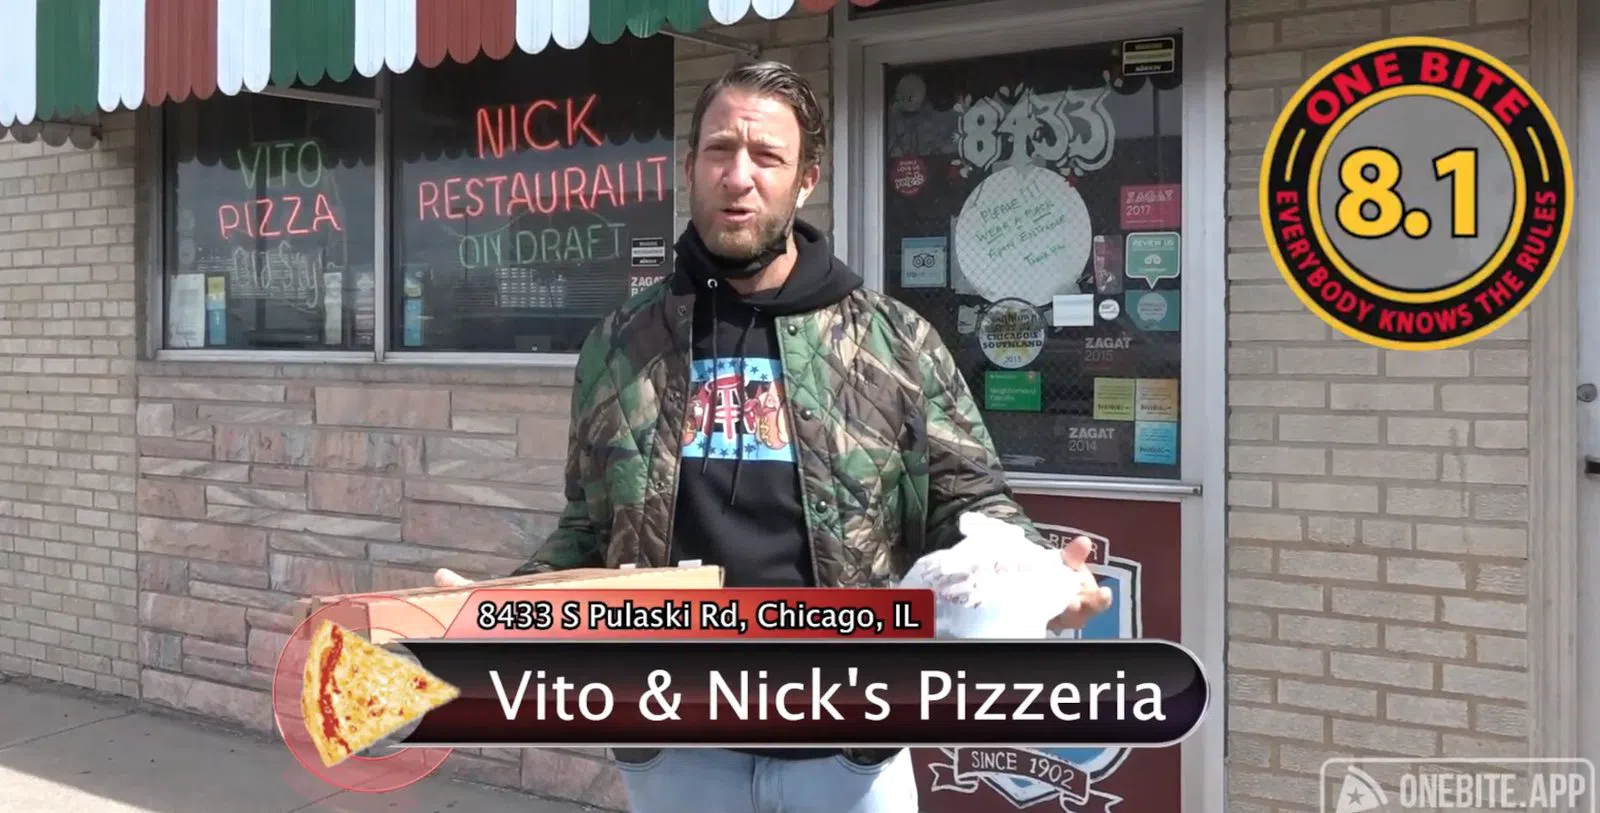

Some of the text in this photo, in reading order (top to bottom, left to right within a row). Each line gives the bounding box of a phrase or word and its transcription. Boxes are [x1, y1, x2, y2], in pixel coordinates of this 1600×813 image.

[476, 95, 604, 159] NICK
[958, 88, 1116, 171] 8433
[236, 140, 323, 190] VITO
[1126, 190, 1174, 204] ZAGAT
[217, 194, 342, 240] PIZZA
[1126, 205, 1151, 217] 2017
[459, 223, 625, 269] ON DRAFT
[631, 276, 664, 287] ZAGA
[982, 340, 1042, 350] SOUTHLAND
[1084, 337, 1132, 349] ZAGAT
[1085, 350, 1113, 361] 2015
[1068, 427, 1115, 439] ZAGAT
[1068, 440, 1097, 452] 2014
[1049, 533, 1099, 560] BER
[971, 750, 1075, 789] SINCE 1902
